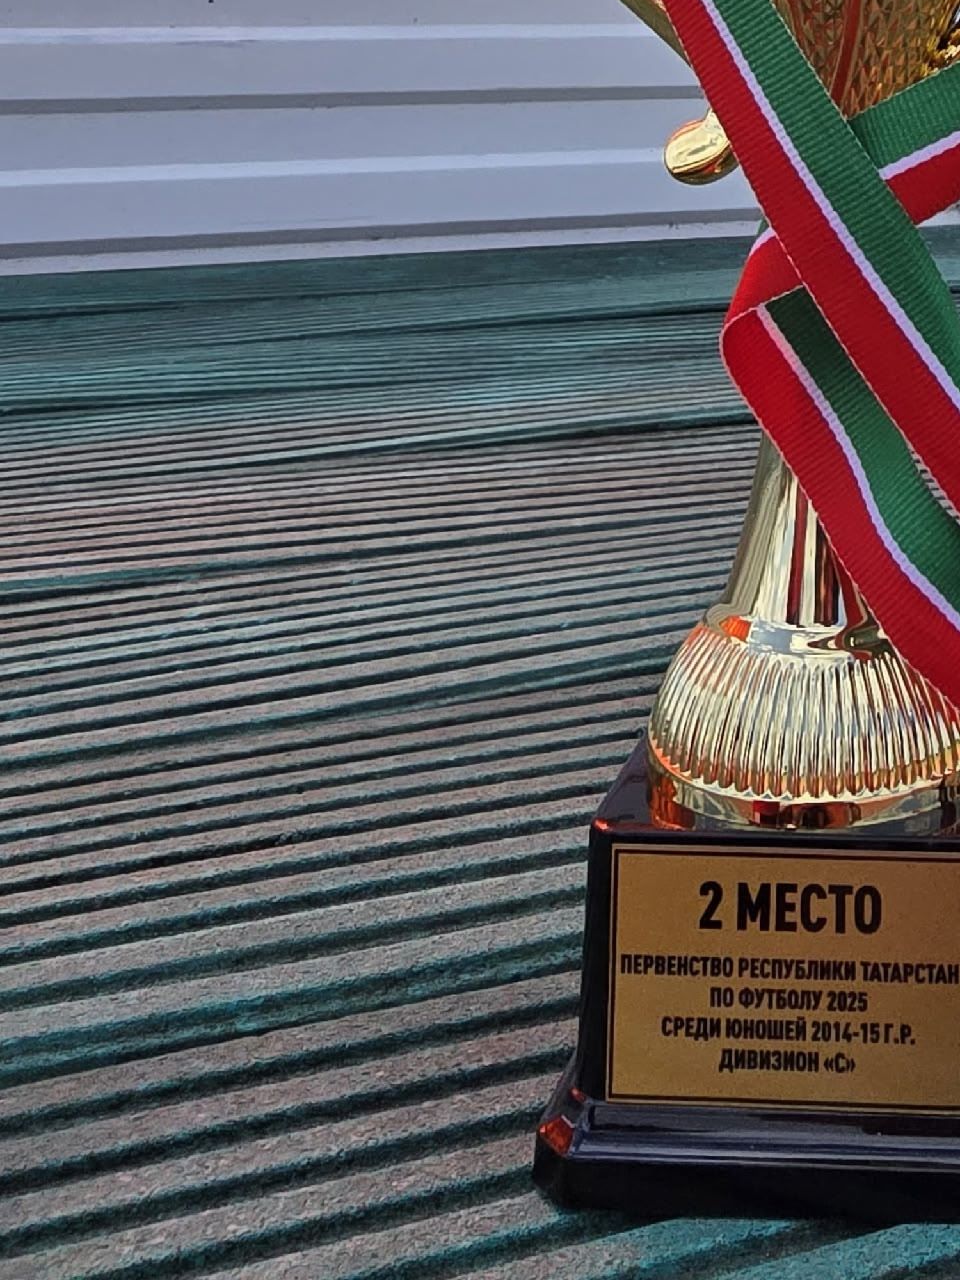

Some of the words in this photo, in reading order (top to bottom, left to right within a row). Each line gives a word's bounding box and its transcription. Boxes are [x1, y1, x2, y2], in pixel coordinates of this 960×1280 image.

[698, 880, 724, 930] 2
[736, 882, 882, 935] МЕСТО
[620, 953, 734, 978] ПЕРВЕНСТВО
[738, 957, 857, 982] РЕСПУБЛИКИ
[859, 960, 960, 985] ТАТАРСТАН
[709, 986, 735, 1008] ПО
[738, 986, 823, 1011] ФУТБОЛУ
[826, 990, 868, 1013] 2025
[661, 1015, 722, 1042] СРЕДИ
[725, 1015, 807, 1042] ЮНОШЕЙ
[810, 1020, 881, 1044] 2014-15
[718, 1047, 820, 1074] ДИВИЗИОН
